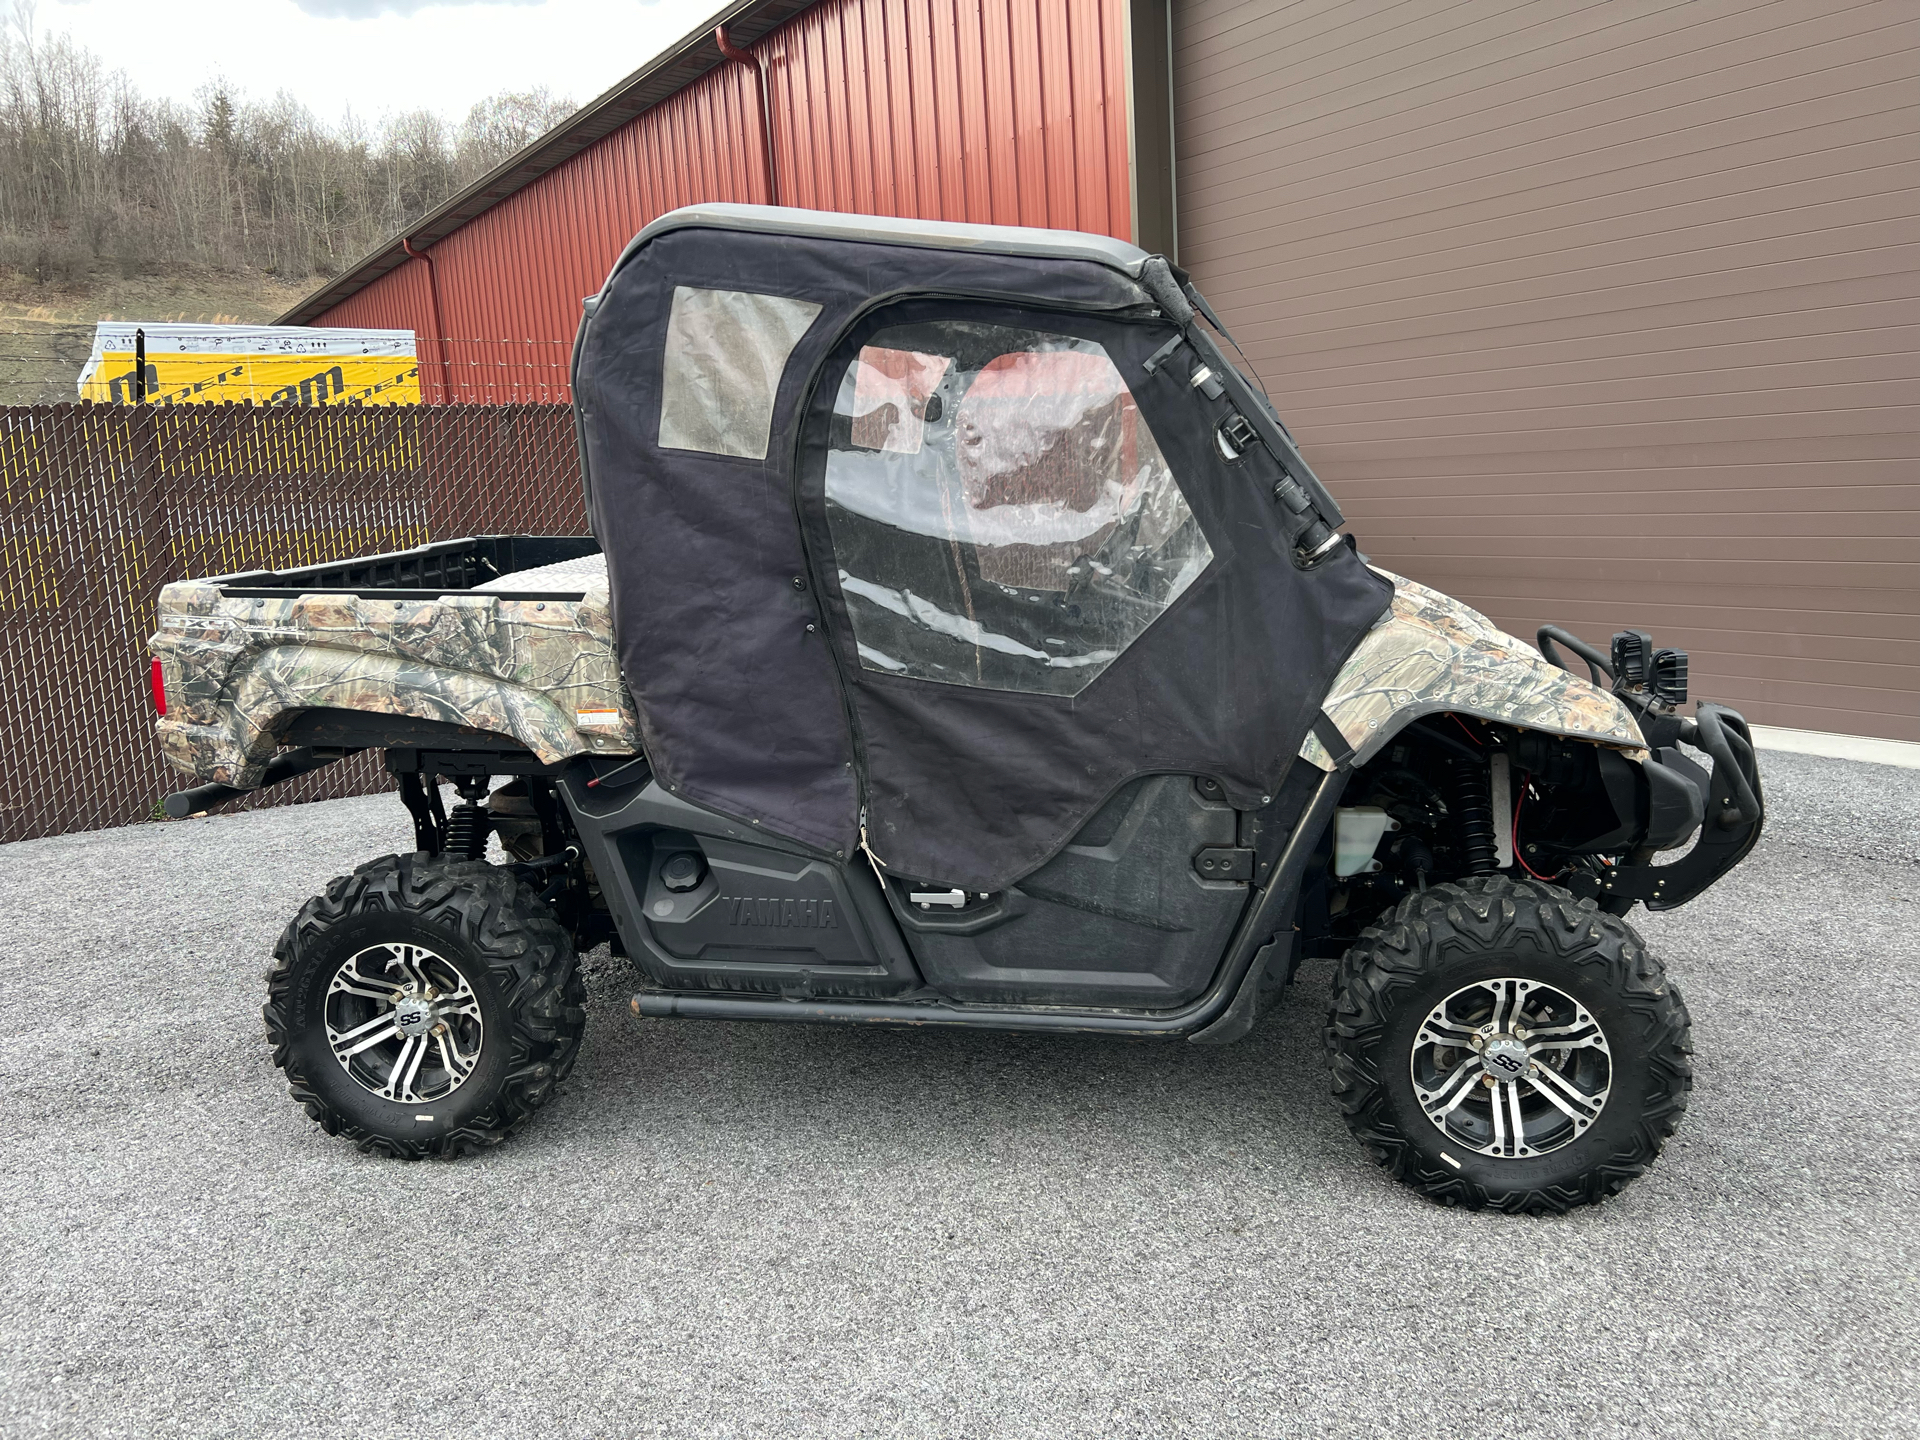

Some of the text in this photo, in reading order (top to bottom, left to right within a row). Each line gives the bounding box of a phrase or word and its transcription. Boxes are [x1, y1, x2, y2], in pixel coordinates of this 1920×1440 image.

[722, 896, 839, 929] YAMAHA
[400, 1011, 421, 1027] SS
[1492, 1053, 1523, 1073] SS
